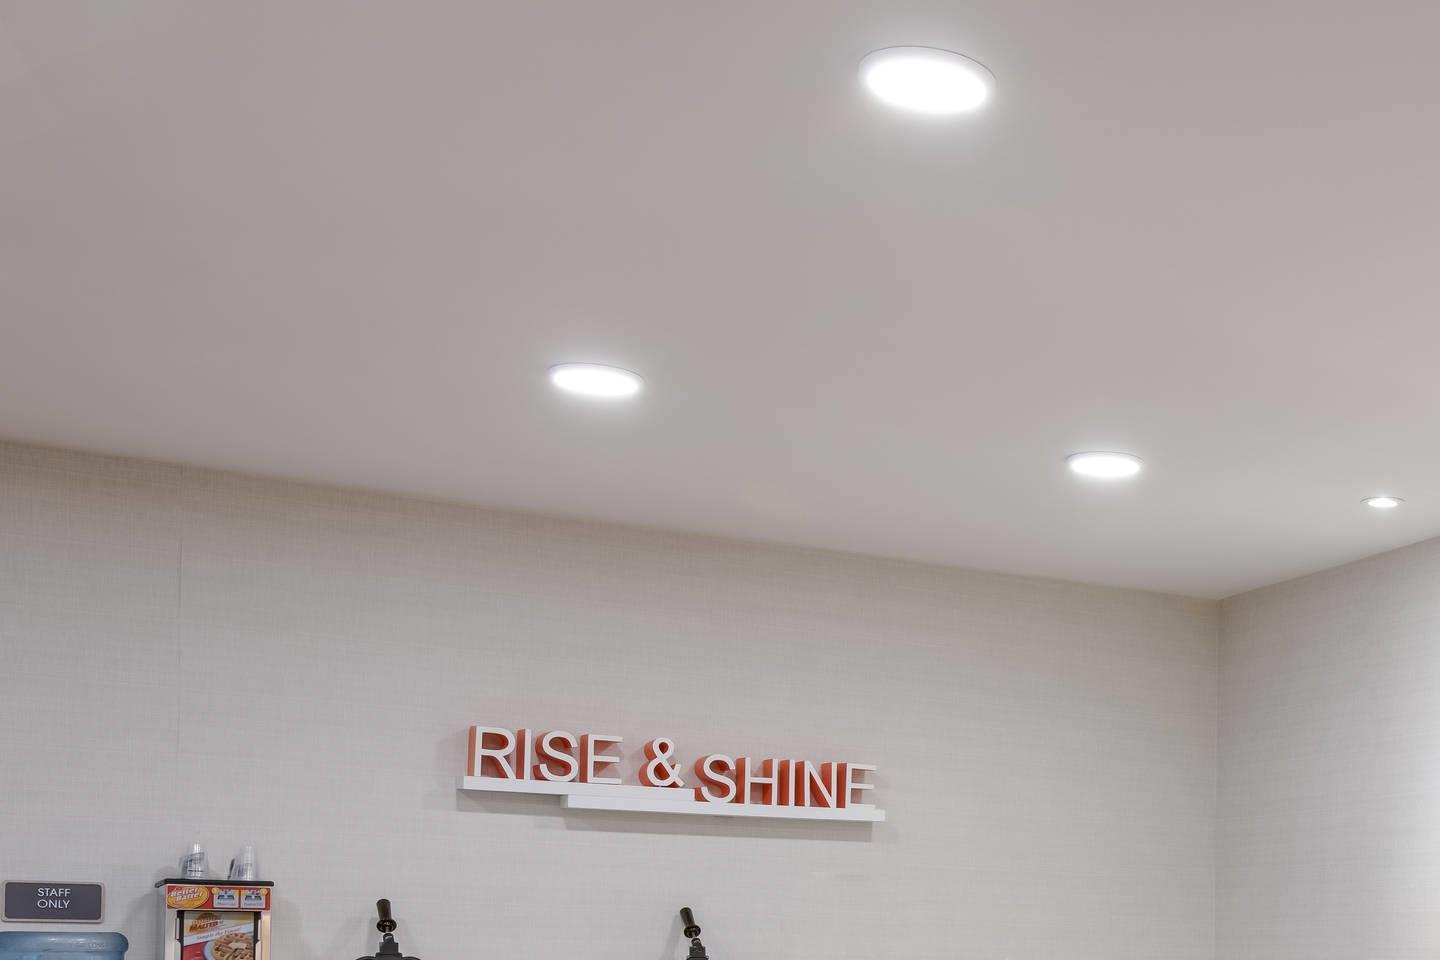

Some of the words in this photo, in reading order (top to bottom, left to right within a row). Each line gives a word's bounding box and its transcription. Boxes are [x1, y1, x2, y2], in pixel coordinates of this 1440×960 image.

[468, 726, 624, 785] RISE
[638, 737, 685, 788] &
[694, 753, 877, 809] SHINE
[37, 888, 71, 897] STAFF
[37, 899, 70, 909] ONLY
